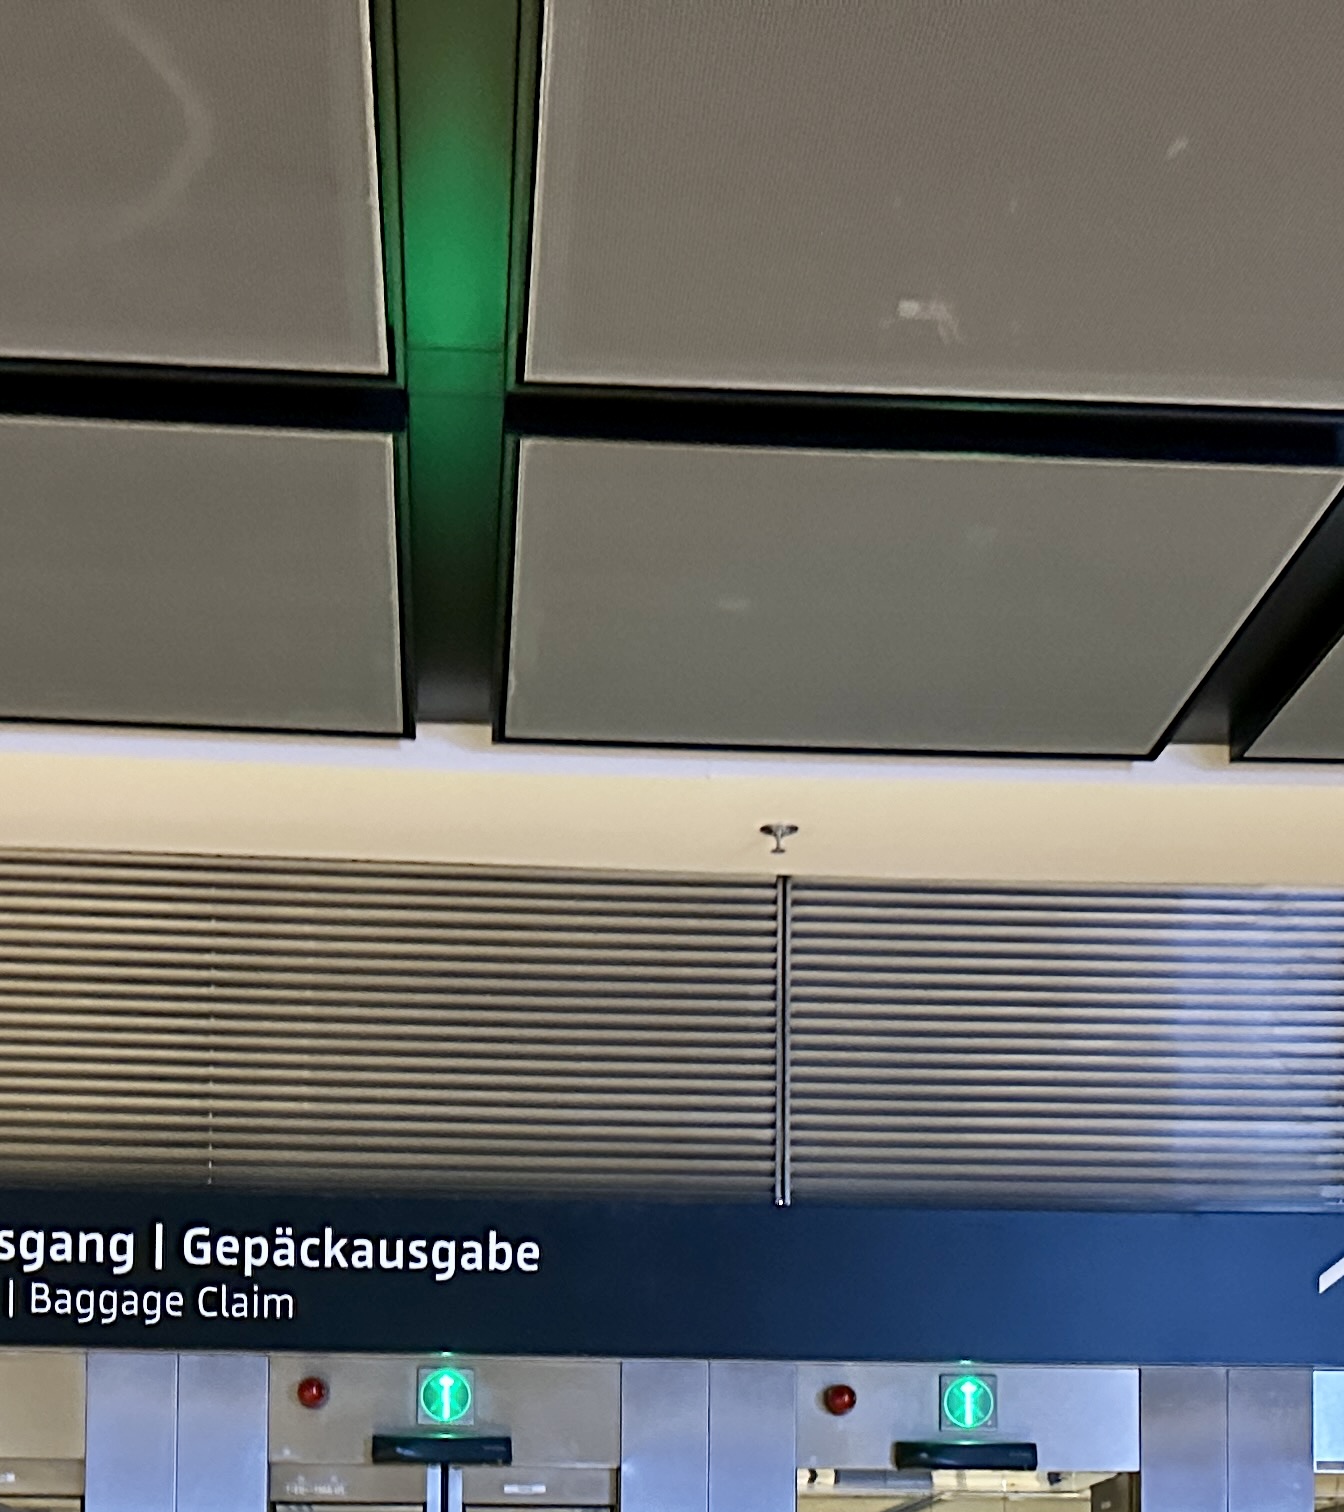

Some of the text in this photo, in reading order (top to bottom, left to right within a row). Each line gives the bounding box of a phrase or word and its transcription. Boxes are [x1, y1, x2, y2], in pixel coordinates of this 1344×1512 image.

[182, 1225, 541, 1282] Gepäckausgabe
[29, 1280, 184, 1325] Baggage
[197, 1283, 295, 1320] Claim
